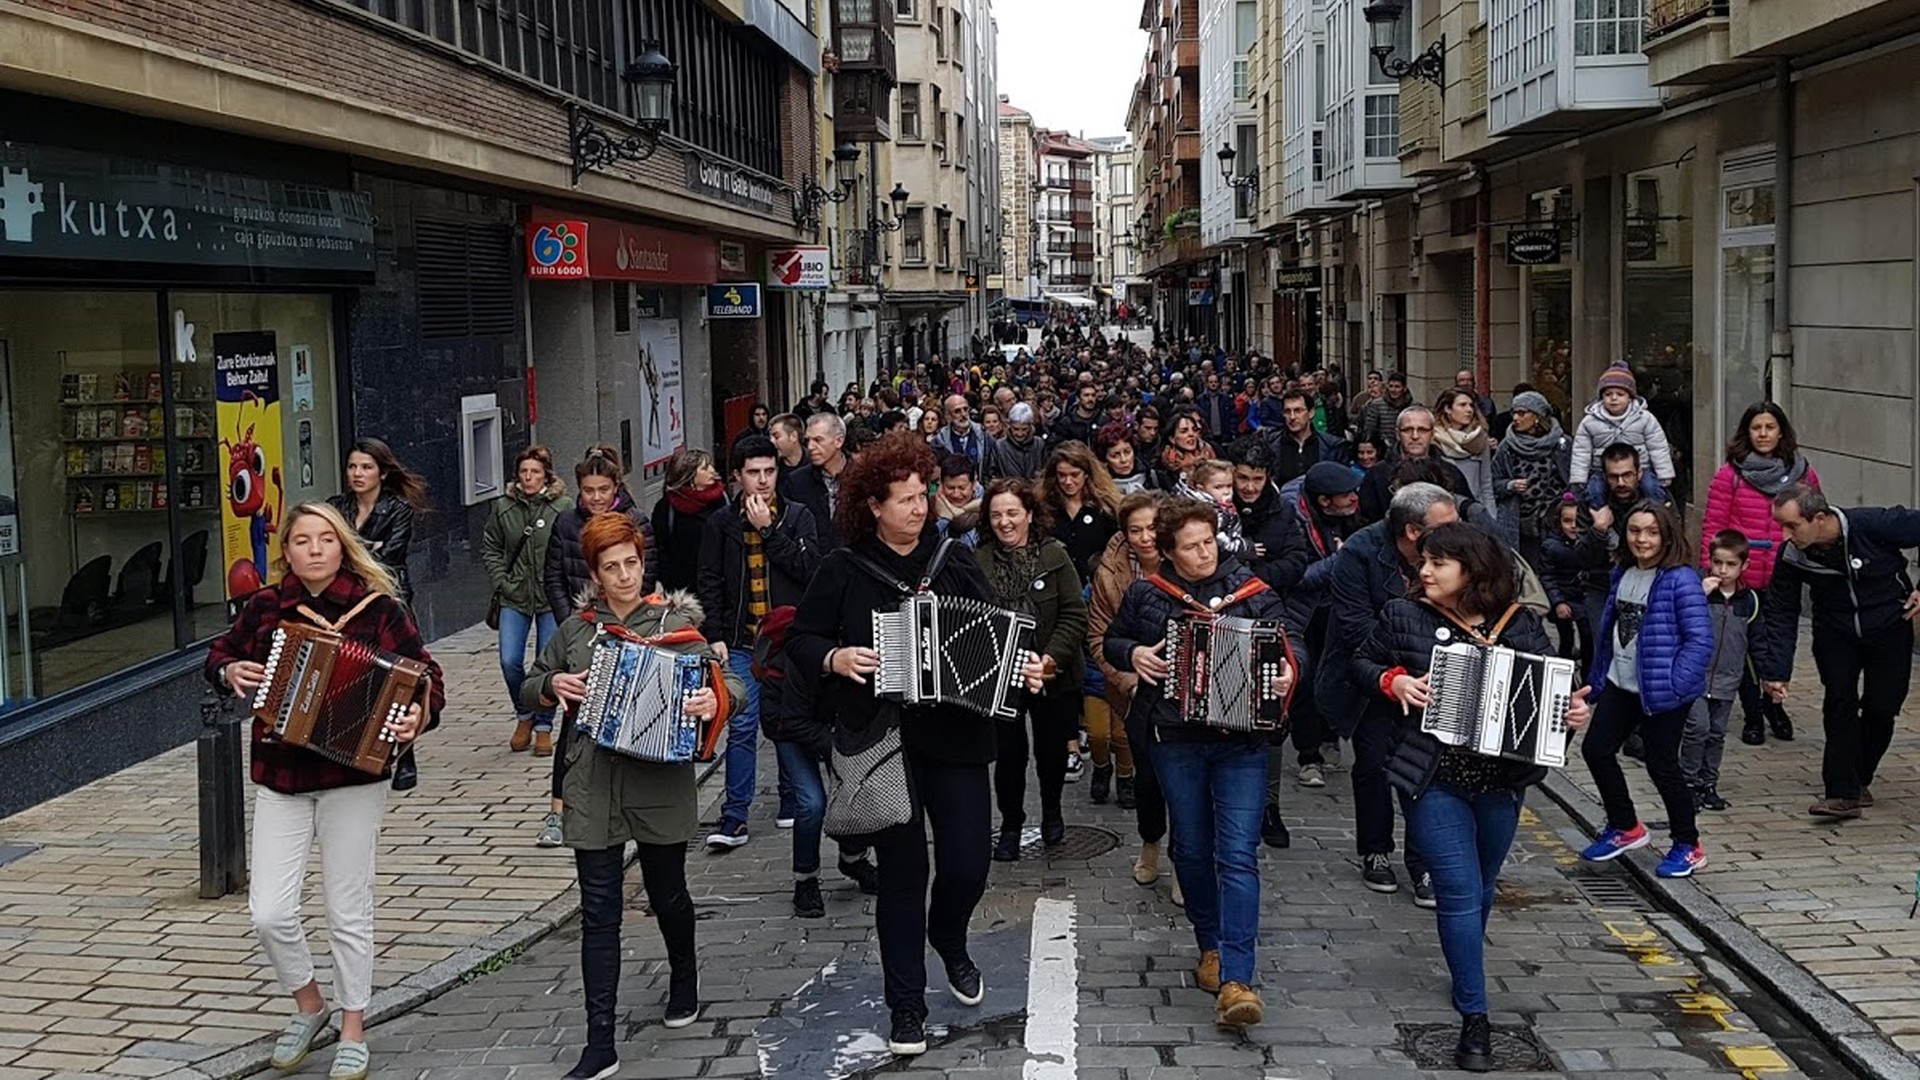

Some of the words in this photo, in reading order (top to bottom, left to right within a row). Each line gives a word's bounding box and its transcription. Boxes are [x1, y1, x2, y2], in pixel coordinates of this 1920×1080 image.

[59, 182, 178, 242] kutxa
[233, 204, 276, 223] gipuzkoa
[278, 208, 317, 226] donostia
[317, 212, 342, 229] kutxa
[234, 229, 255, 248] caja
[257, 230, 298, 250] gipuzkoa
[299, 236, 315, 248] san
[629, 237, 669, 271] Santander
[530, 266, 556, 275] EURO
[557, 266, 583, 275] 6000
[712, 305, 753, 315] TELEBANCO
[173, 308, 197, 363] k
[217, 354, 235, 370] Zure
[234, 352, 276, 369] Etorkizunak
[226, 371, 249, 387] Behar
